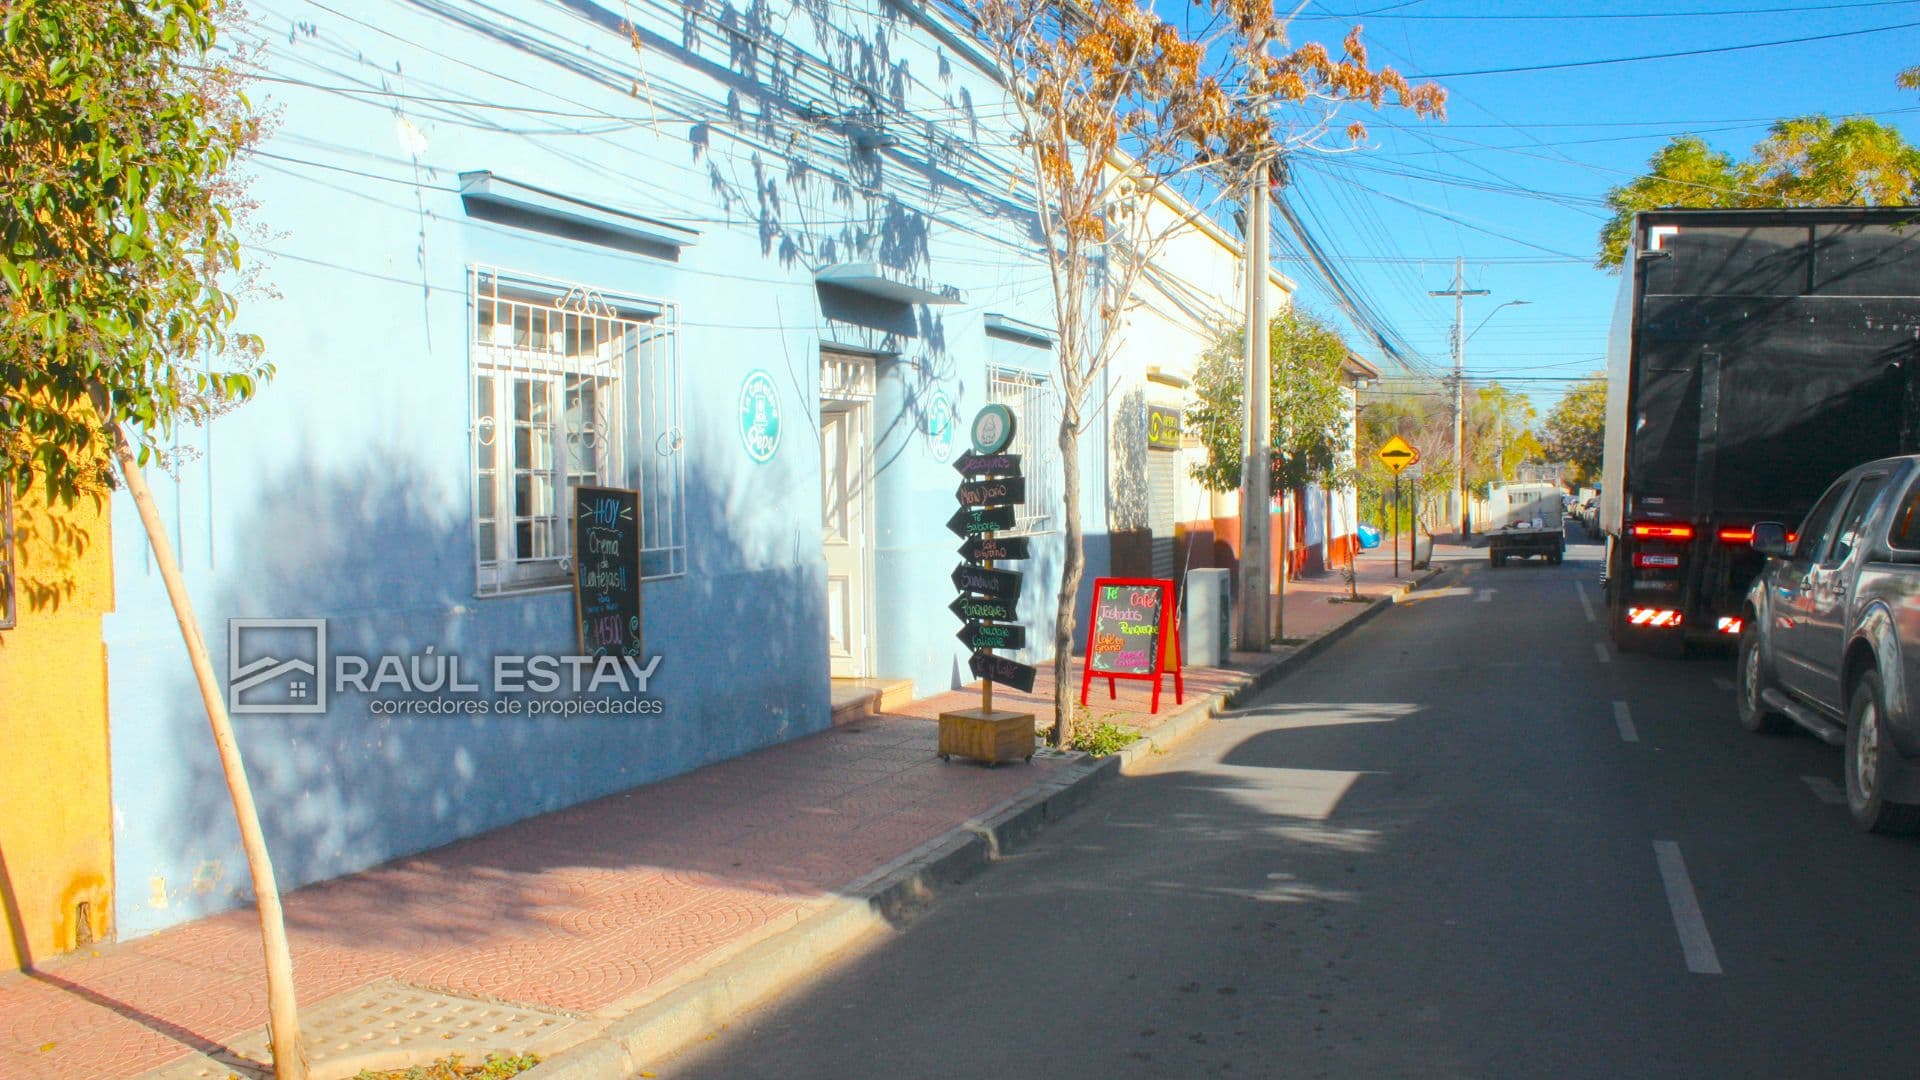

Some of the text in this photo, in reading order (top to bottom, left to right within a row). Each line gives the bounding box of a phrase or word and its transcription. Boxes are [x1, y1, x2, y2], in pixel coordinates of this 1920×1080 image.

[594, 498, 620, 528] HOY
[1105, 587, 1157, 608] Té Café
[1100, 605, 1143, 621] Tostadas
